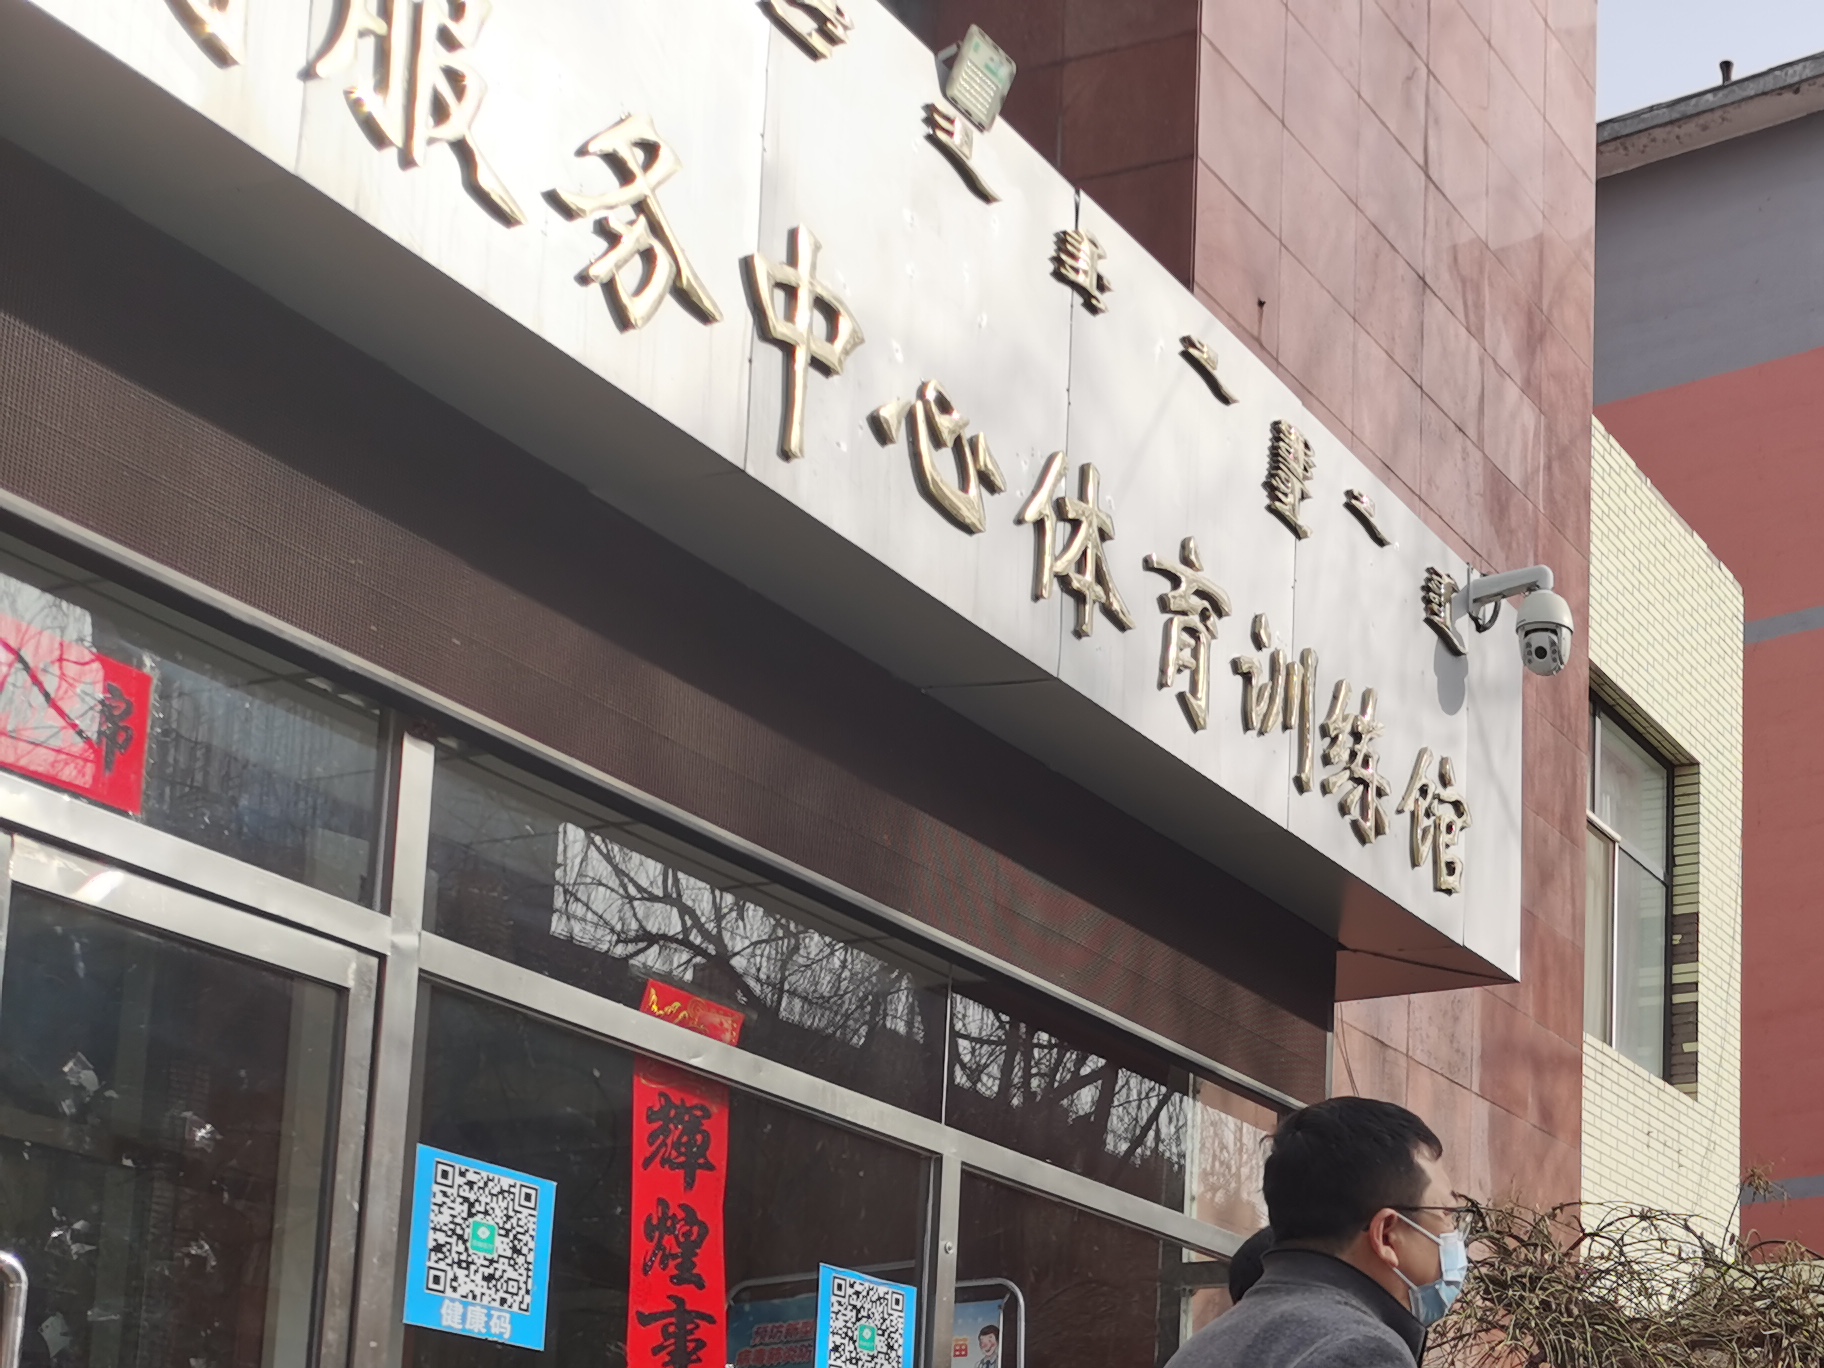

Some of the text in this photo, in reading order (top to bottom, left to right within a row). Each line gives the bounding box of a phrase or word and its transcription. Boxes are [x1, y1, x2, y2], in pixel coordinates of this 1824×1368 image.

[165, 0, 1473, 895] 服务中心体育训练馆
[439, 1298, 512, 1341] 健康码
